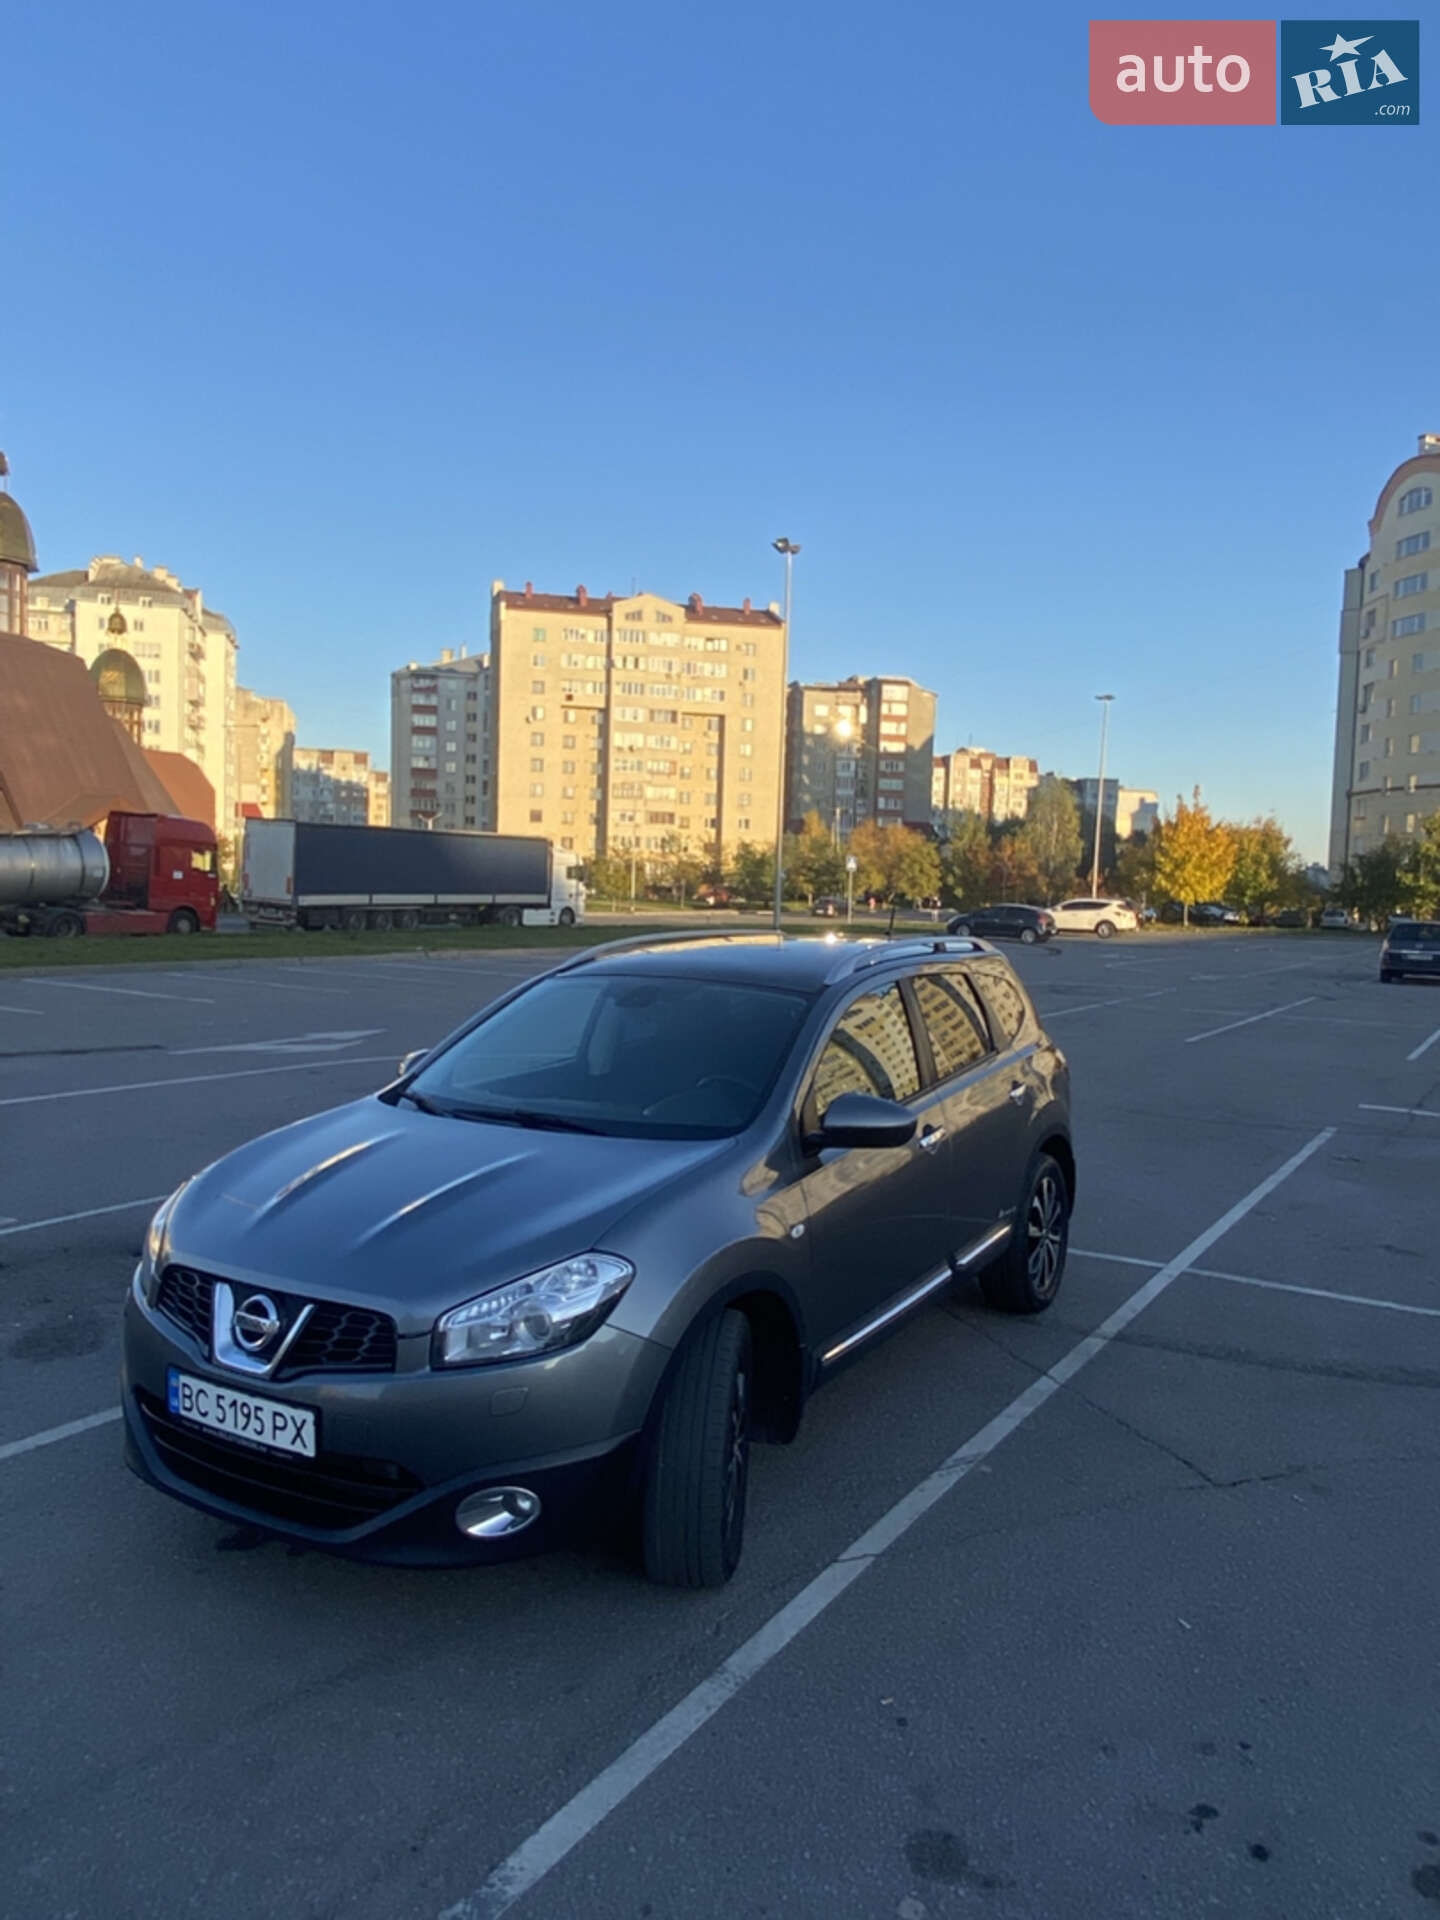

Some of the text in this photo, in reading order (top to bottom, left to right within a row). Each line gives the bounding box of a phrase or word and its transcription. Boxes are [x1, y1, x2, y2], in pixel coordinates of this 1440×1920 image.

[181, 1382, 209, 1418] BC
[216, 1394, 265, 1436] 5195
[272, 1411, 308, 1449] PX
